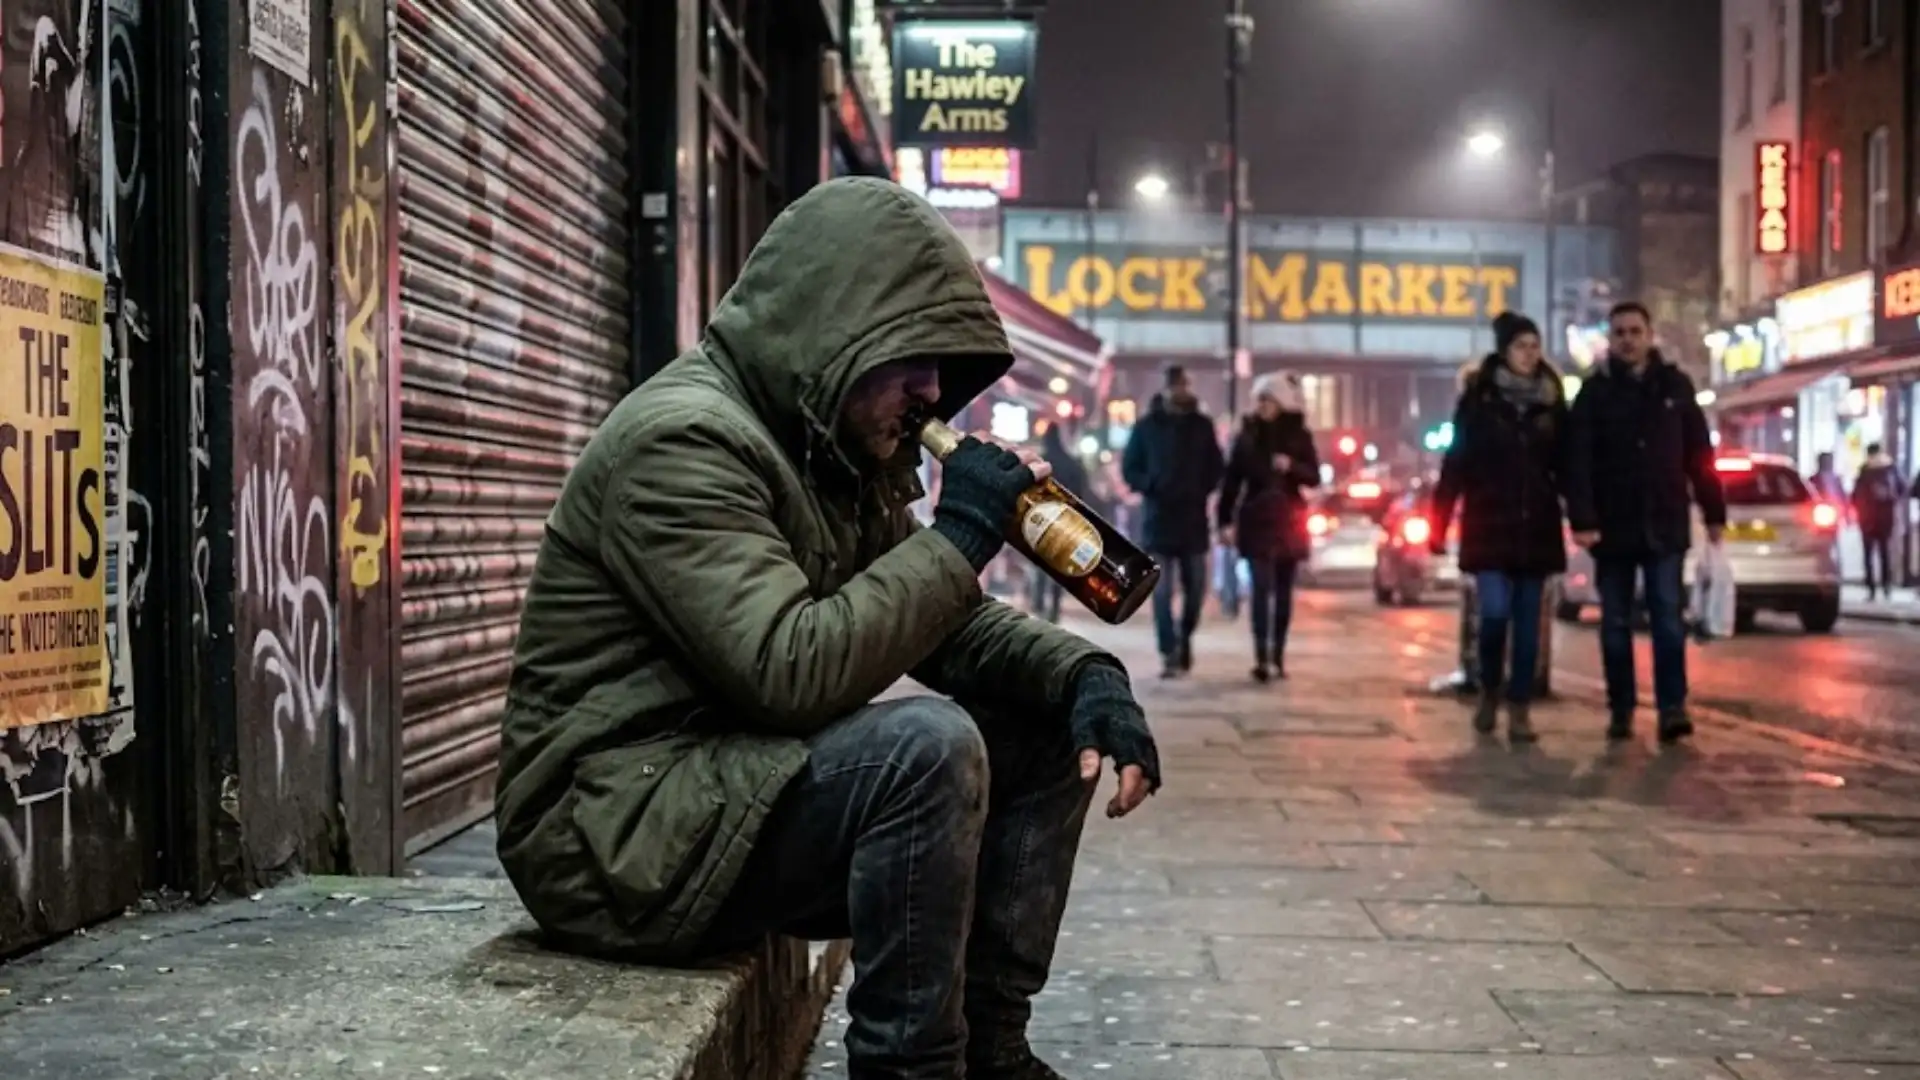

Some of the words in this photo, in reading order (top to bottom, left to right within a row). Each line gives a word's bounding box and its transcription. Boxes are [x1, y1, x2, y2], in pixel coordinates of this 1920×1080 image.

[932, 37, 997, 68] The
[905, 68, 1025, 105] Hawley
[919, 102, 1010, 132] Arms
[1024, 245, 1207, 316] LOCK
[1244, 252, 1518, 320] MARKET
[19, 326, 70, 418] THE
